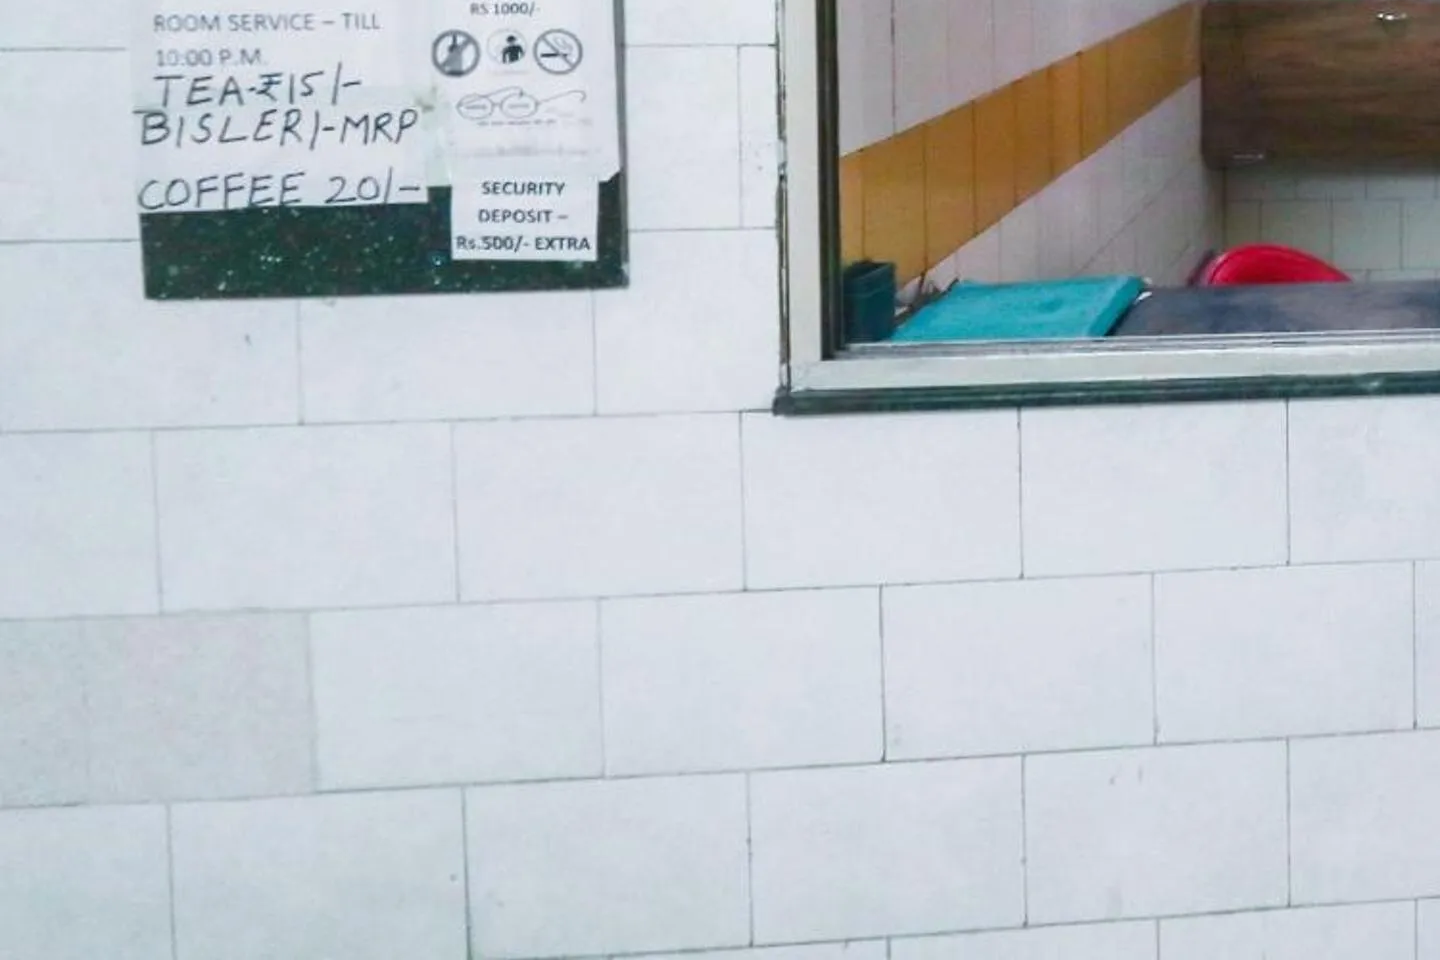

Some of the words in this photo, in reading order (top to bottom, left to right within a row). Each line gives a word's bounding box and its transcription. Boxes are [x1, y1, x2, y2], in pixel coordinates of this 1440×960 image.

[470, 3, 490, 15] RS
[153, 14, 221, 32] ROOM
[227, 13, 315, 32] SERVICE
[341, 12, 382, 30] TILL
[156, 48, 213, 67] 10:00
[138, 171, 305, 210] COFFEE
[325, 166, 421, 204] 20/-
[481, 181, 566, 195] SECURITY
[478, 209, 552, 223] DEPOSIT
[535, 237, 591, 251] EXTRA
